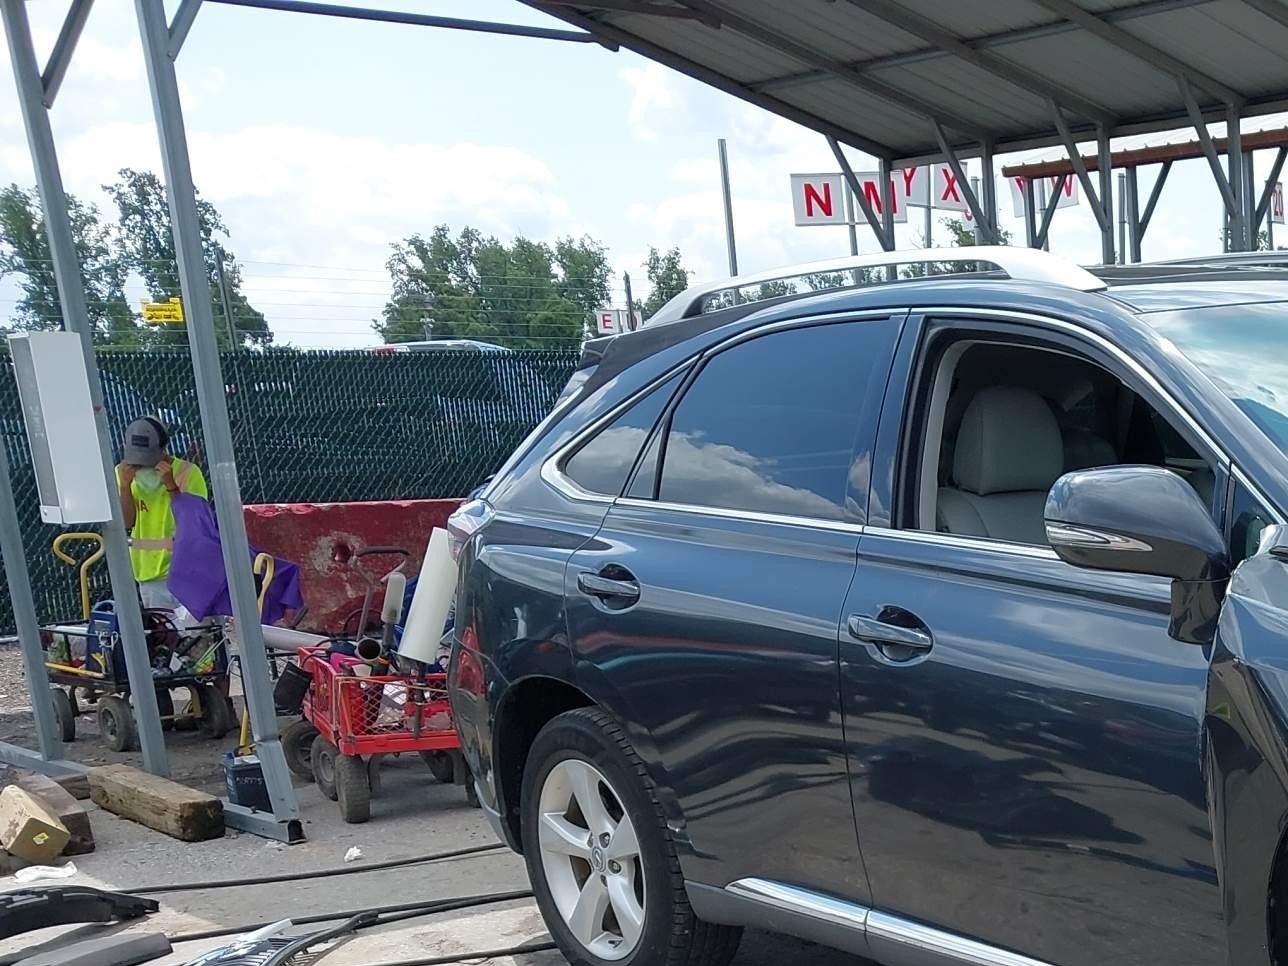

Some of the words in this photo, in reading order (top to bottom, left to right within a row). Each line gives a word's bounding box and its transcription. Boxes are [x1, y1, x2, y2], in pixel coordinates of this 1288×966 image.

[804, 182, 833, 217] N
[941, 168, 960, 203] X
[602, 313, 613, 329] E
